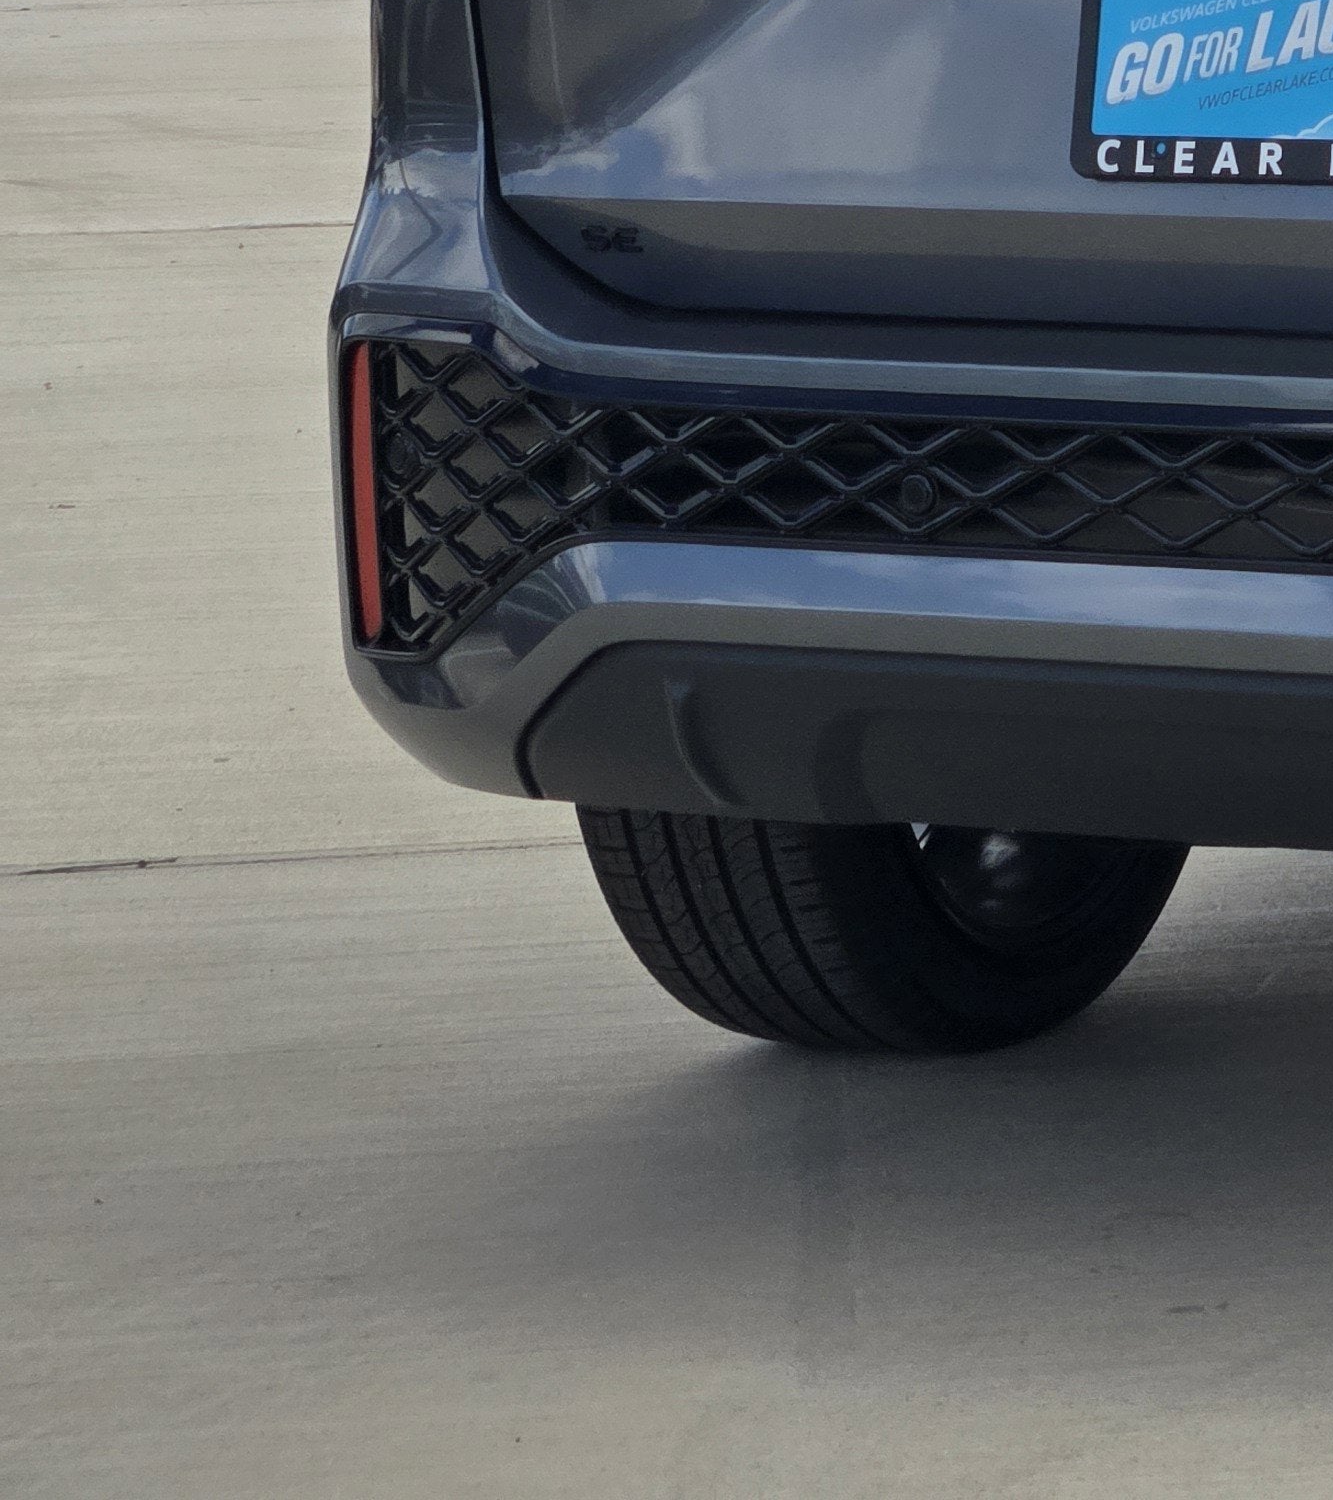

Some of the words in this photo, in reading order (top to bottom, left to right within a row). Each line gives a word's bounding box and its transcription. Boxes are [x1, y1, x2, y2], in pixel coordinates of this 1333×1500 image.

[1106, 32, 1185, 105] GO
[1183, 26, 1244, 83] FOR
[1096, 138, 1283, 176] CLEAR
[579, 225, 644, 253] SE
